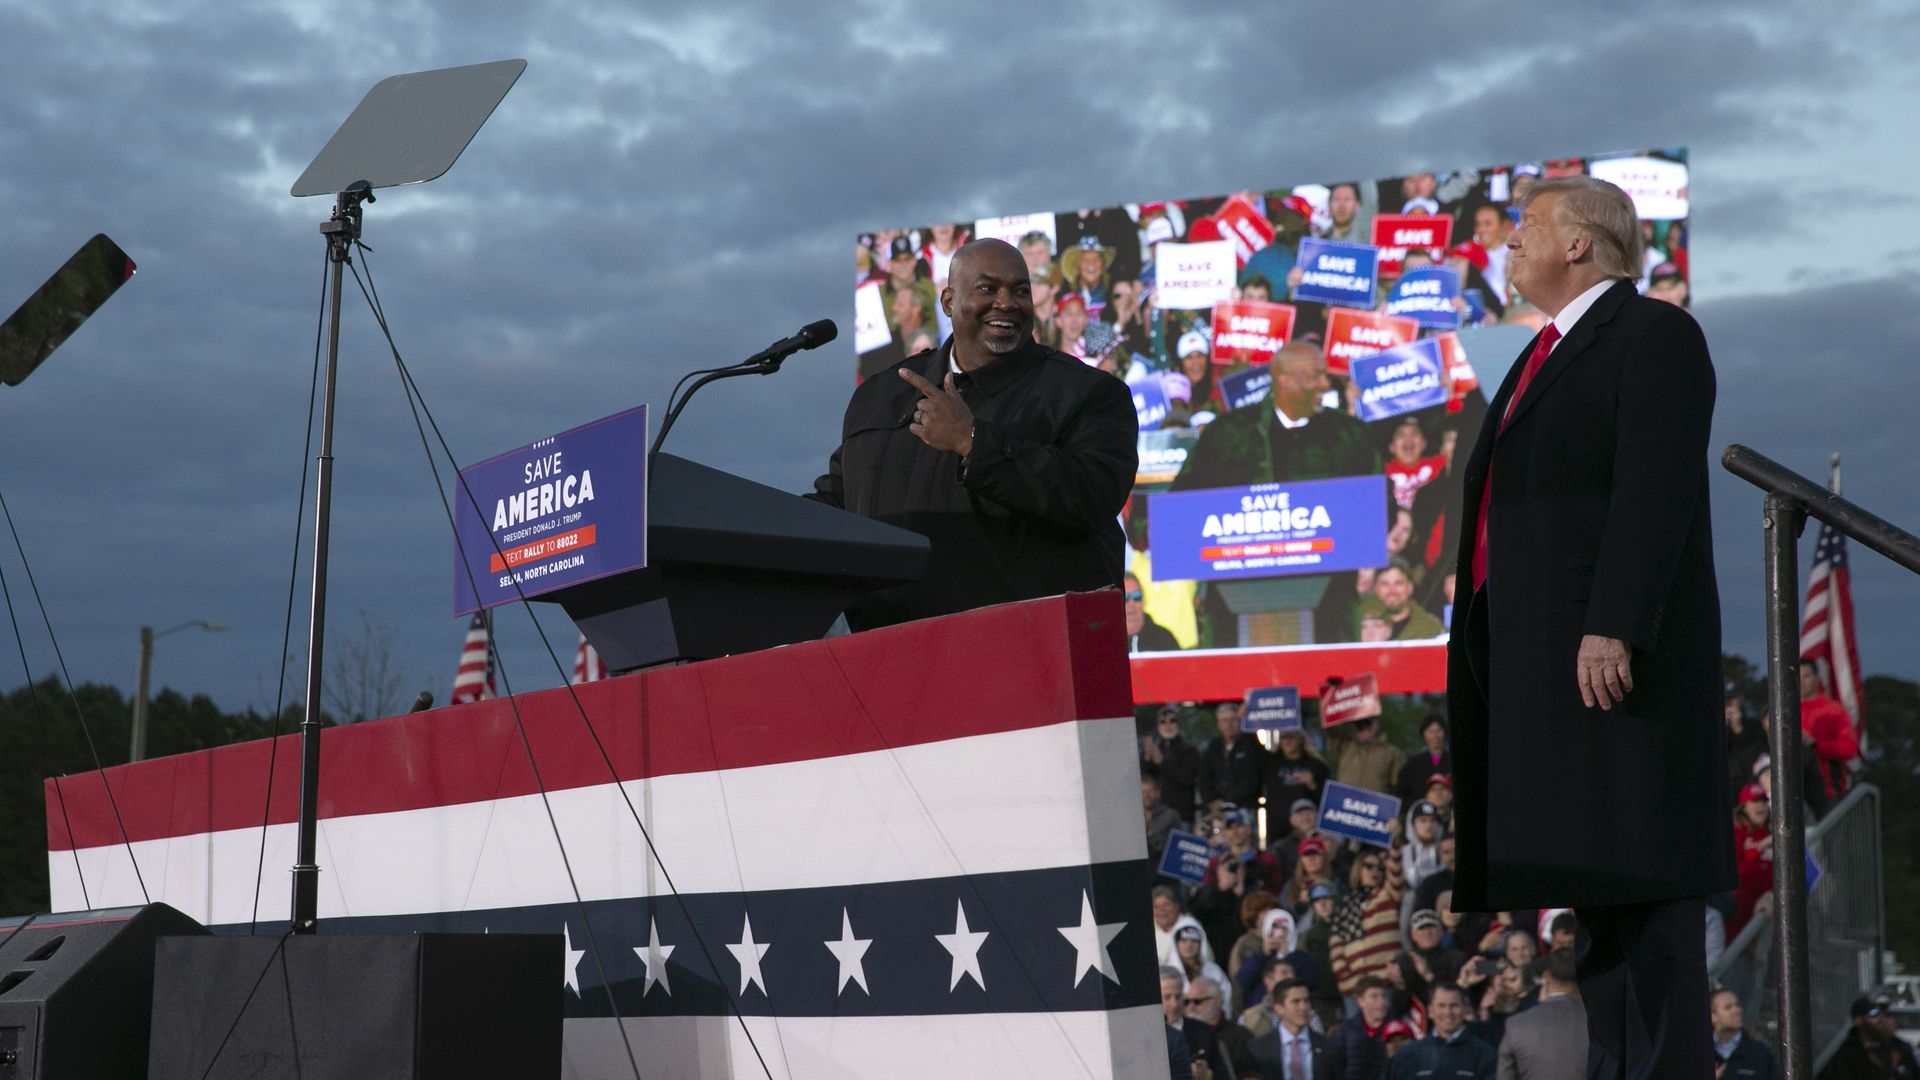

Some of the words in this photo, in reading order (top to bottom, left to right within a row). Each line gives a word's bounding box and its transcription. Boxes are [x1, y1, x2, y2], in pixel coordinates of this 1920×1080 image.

[1318, 255, 1356, 273] SAVE
[1400, 280, 1441, 297] SAVE
[1230, 316, 1270, 334] SAVE
[1351, 326, 1392, 346] SAVE
[1375, 359, 1419, 382] SAVE
[1362, 372, 1439, 404] AMERICA!
[524, 452, 562, 484] SAVE
[492, 469, 595, 532] AMERICA
[1241, 492, 1290, 512] SAVE
[503, 527, 532, 544] PRESIDENT
[533, 519, 556, 535] DONALD
[556, 517, 562, 528] J.
[562, 511, 582, 525] TRUMP
[1202, 505, 1331, 538] AMERICA
[506, 550, 523, 564] TEXT
[523, 543, 545, 559] RALLY
[546, 541, 556, 552] TO
[556, 533, 578, 550] 88022
[524, 565, 548, 581] NORTH
[549, 554, 585, 574] CAROLINA
[1257, 696, 1285, 709] SAVE
[1343, 798, 1379, 817] SAVE
